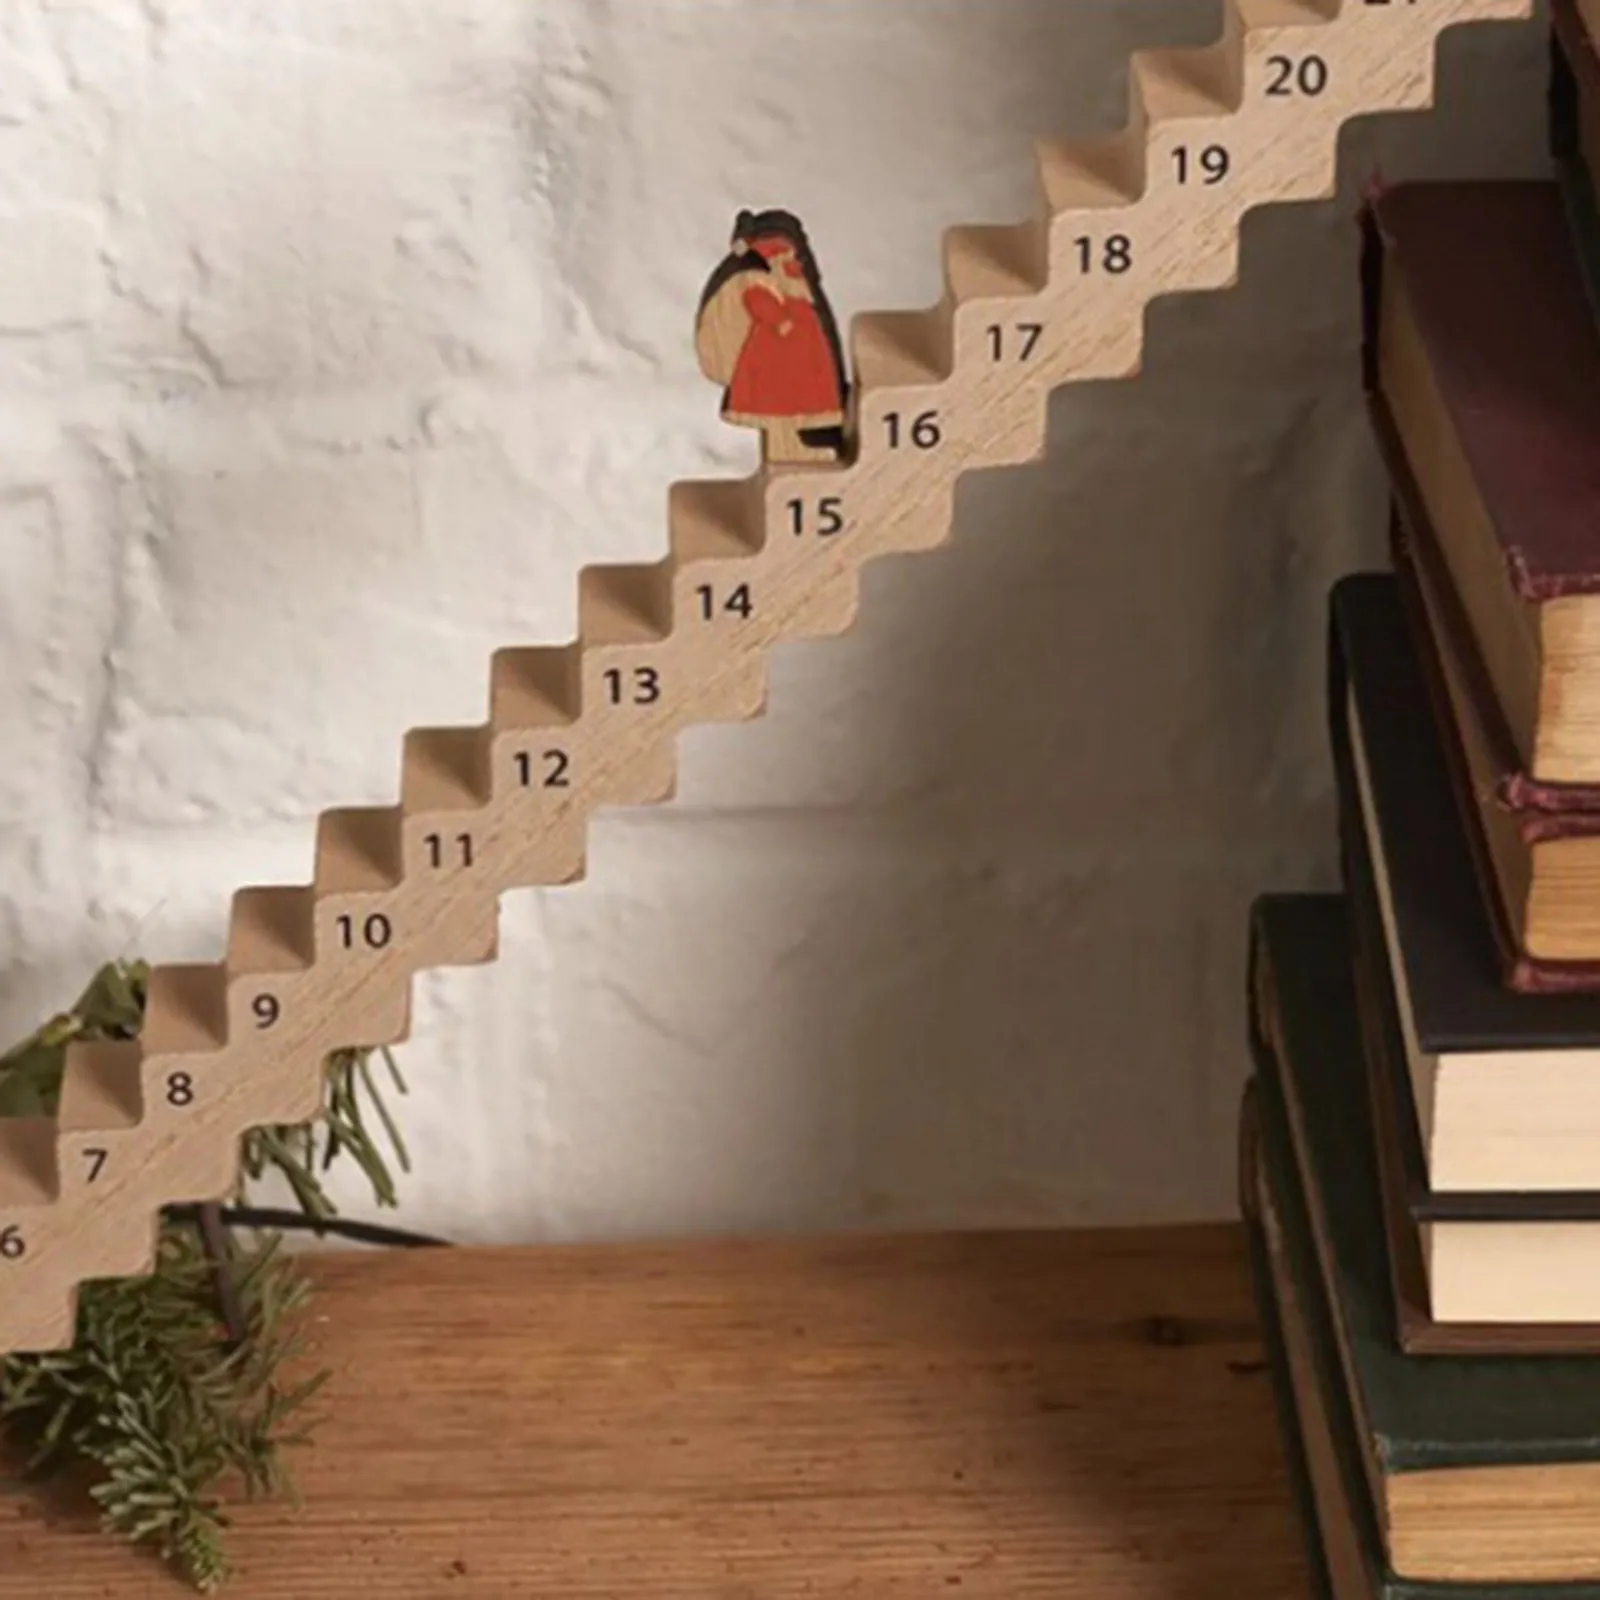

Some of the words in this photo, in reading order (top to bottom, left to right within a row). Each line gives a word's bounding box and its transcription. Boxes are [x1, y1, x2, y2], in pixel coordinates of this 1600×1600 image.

[1265, 55, 1327, 96] 20
[1172, 145, 1229, 185] 19
[1075, 234, 1132, 274] 18
[985, 324, 1043, 361] 17
[883, 411, 940, 449] 16
[786, 497, 843, 536] 15
[696, 583, 753, 620] 14
[604, 667, 660, 704] 13
[513, 749, 569, 787] 12
[425, 832, 473, 868] 11
[336, 913, 392, 949] 10
[252, 994, 280, 1029] 9
[166, 1072, 194, 1106] 8
[82, 1148, 108, 1184] 7
[0, 1225, 25, 1259] 6
